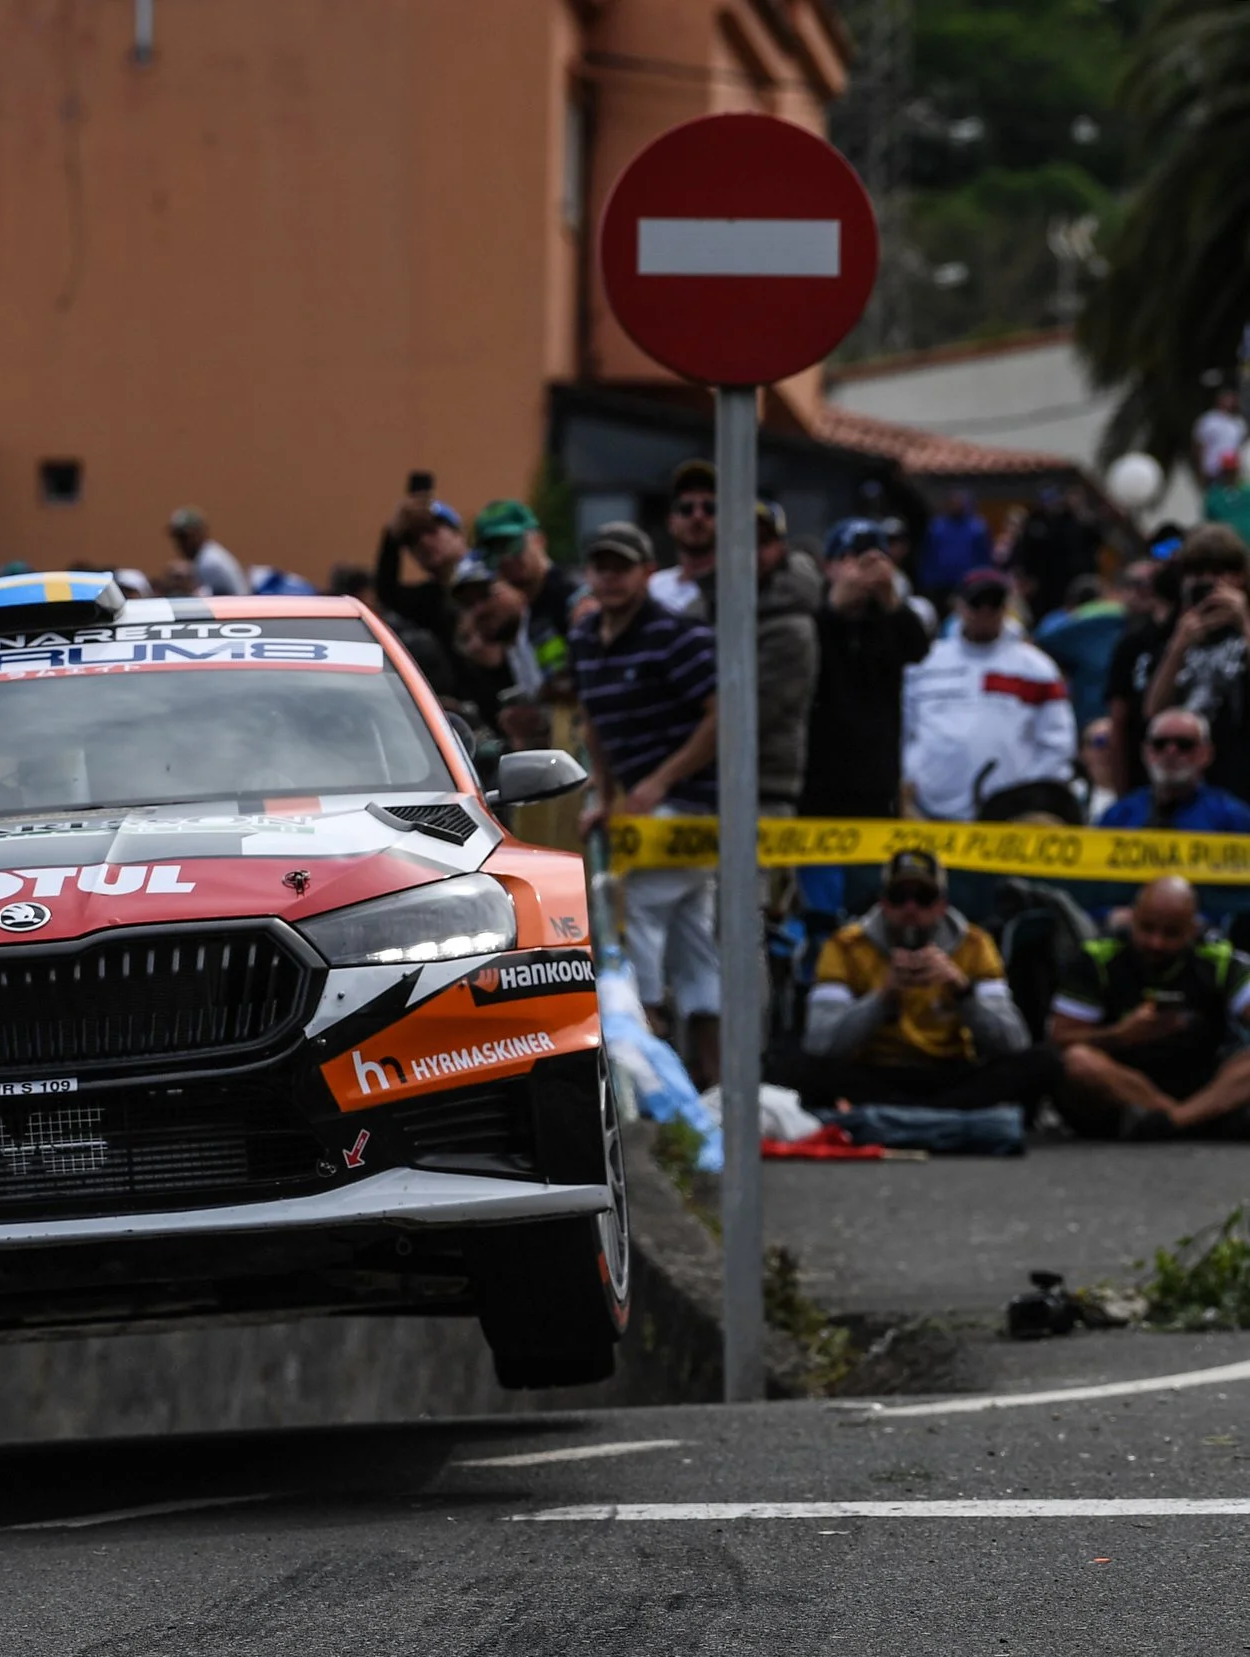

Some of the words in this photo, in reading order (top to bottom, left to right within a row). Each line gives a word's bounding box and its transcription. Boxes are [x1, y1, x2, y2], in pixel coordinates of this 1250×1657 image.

[410, 1031, 556, 1081] HYRMASKINER
[21, 1082, 33, 1094] S
[40, 1080, 71, 1093] 109
